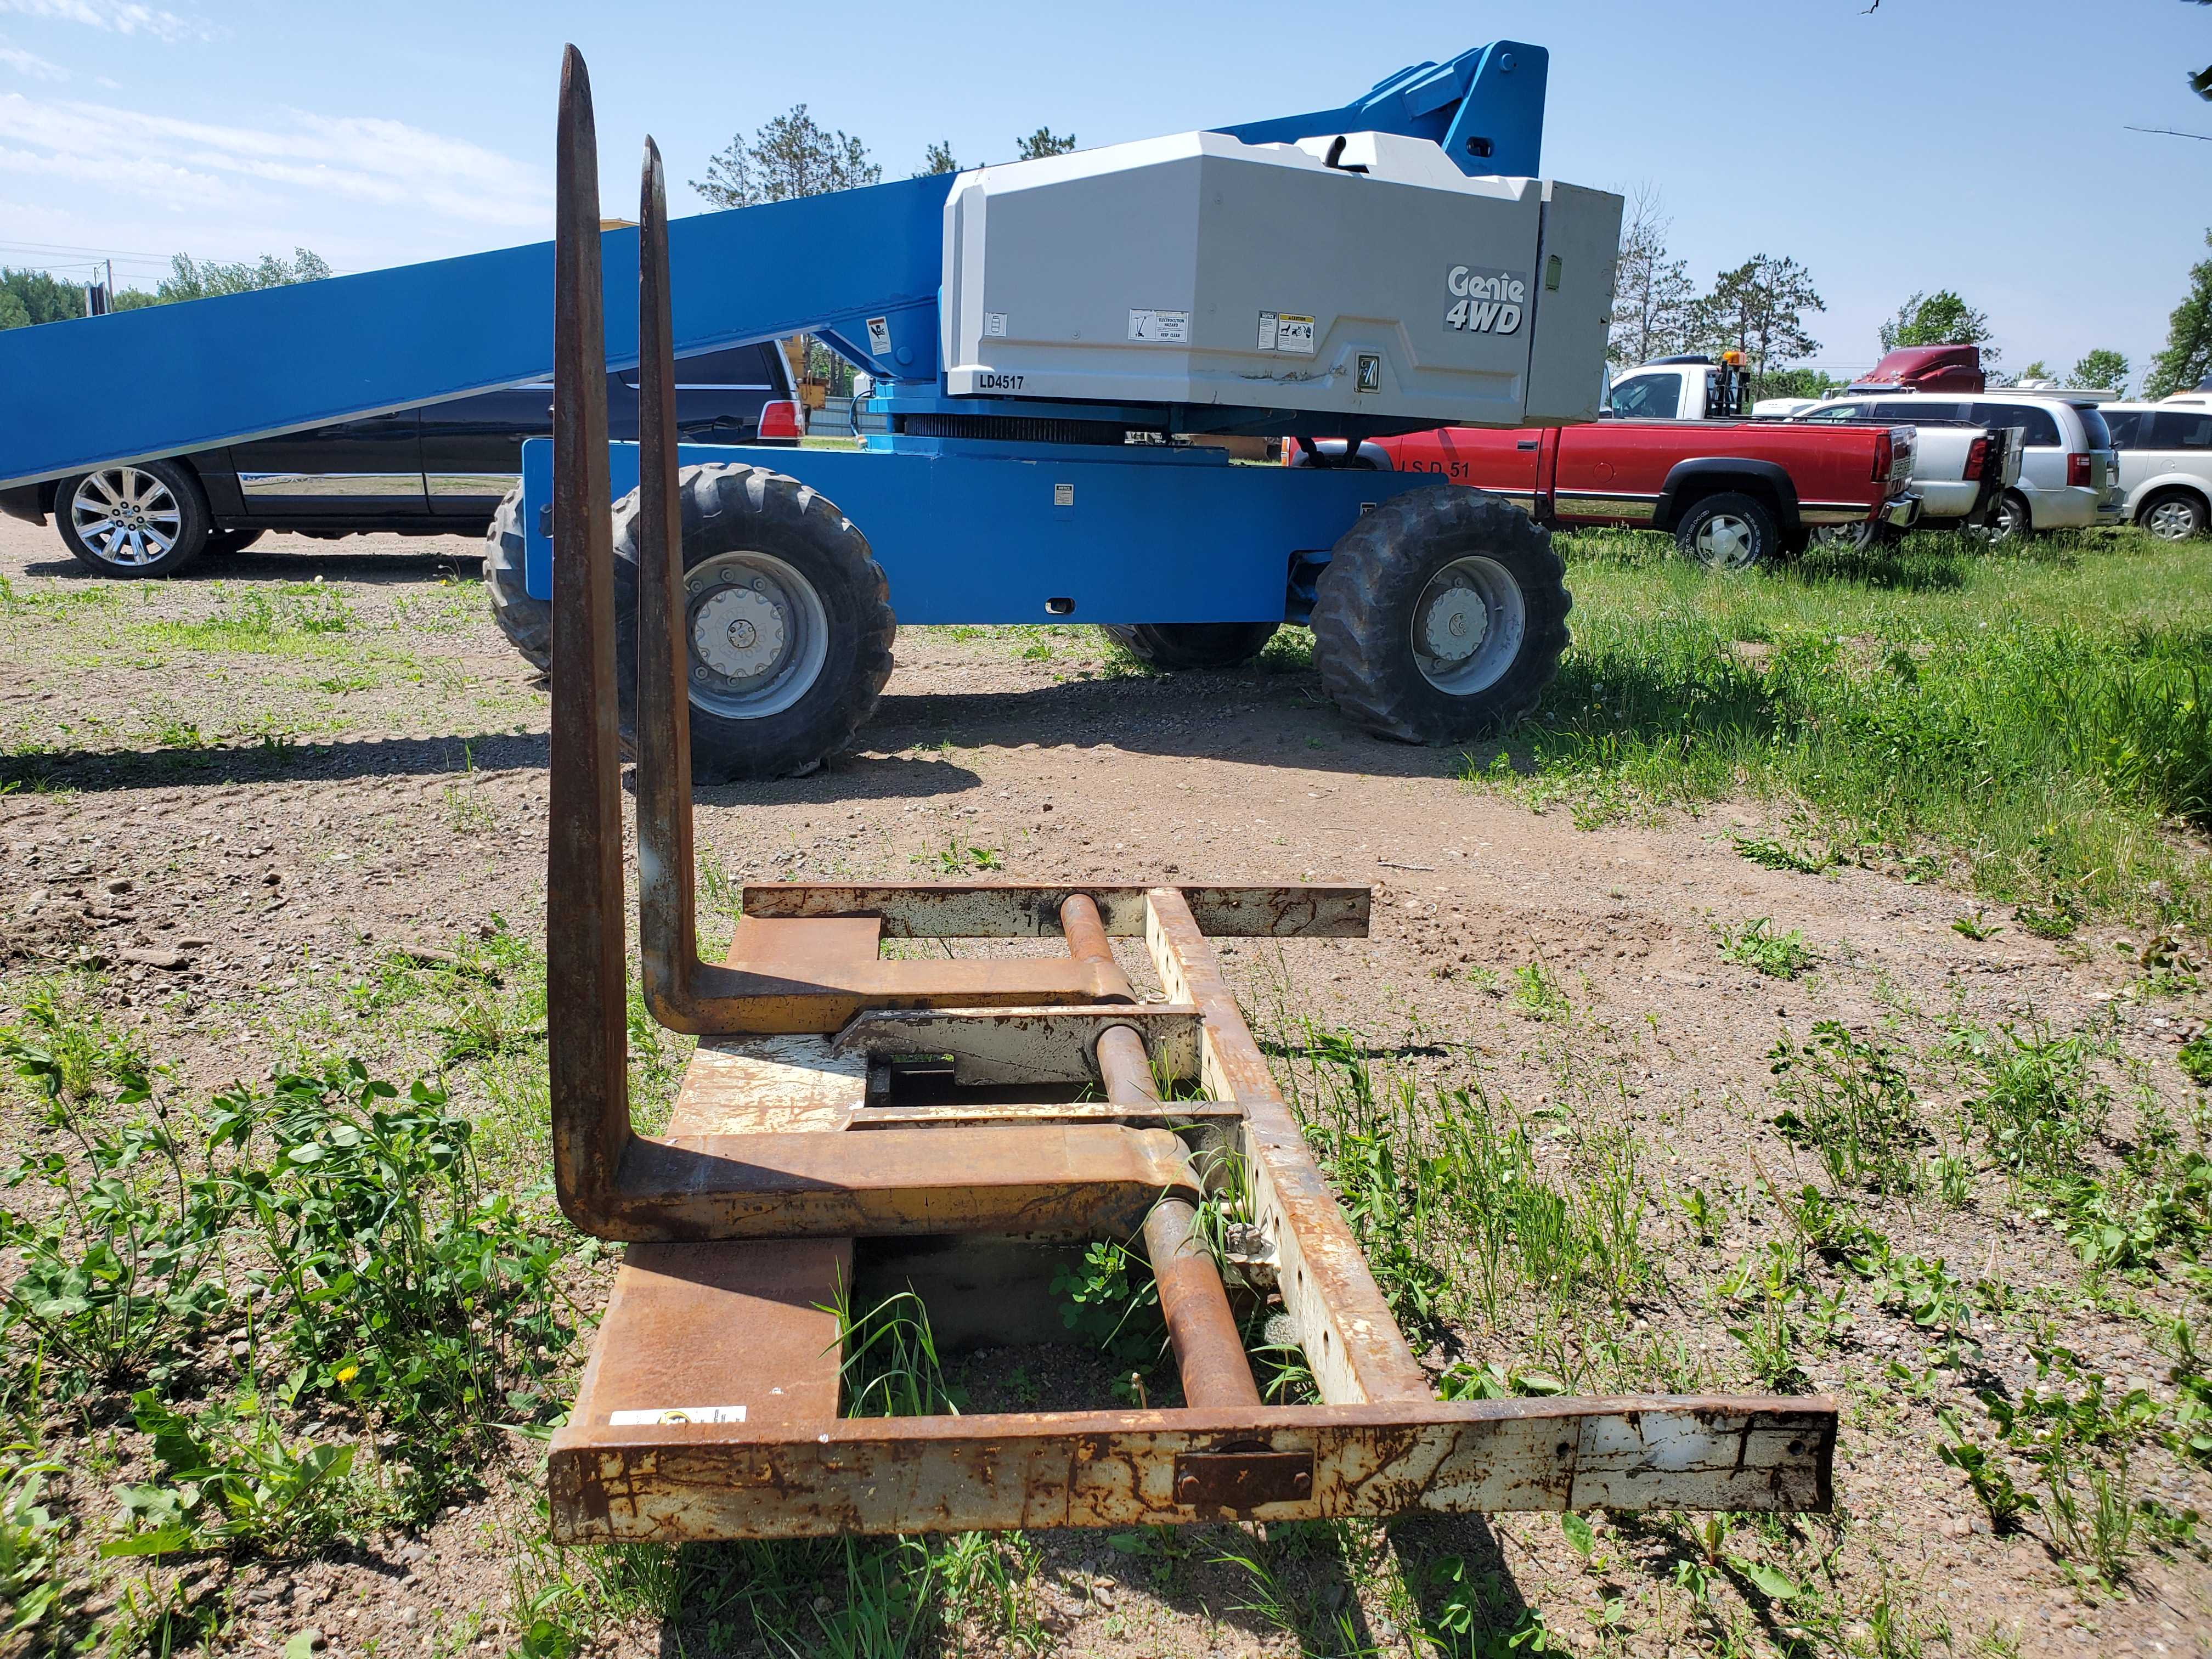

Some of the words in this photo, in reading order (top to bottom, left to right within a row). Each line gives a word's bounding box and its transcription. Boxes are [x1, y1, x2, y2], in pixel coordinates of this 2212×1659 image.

[1448, 266, 1525, 303] Genie
[1446, 300, 1522, 335] 4WD
[980, 374, 1024, 390] LD4517
[1450, 462, 1469, 478] 51
